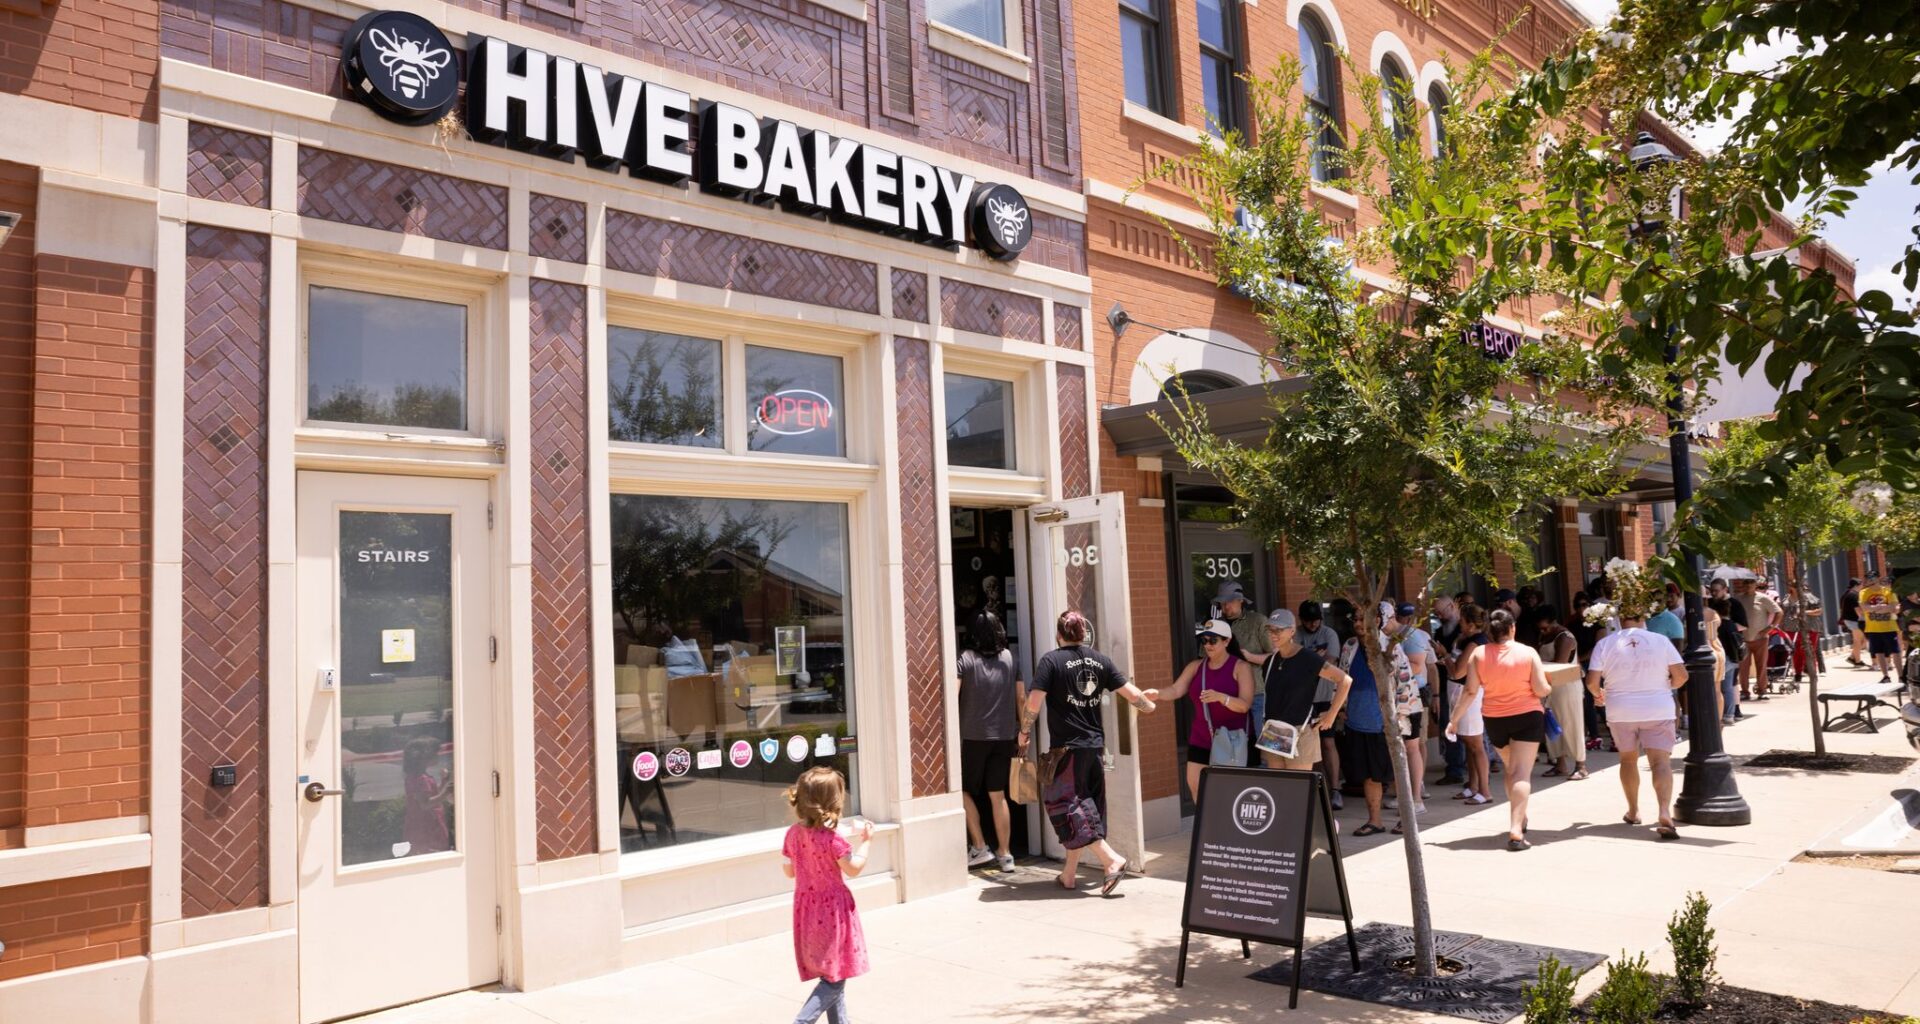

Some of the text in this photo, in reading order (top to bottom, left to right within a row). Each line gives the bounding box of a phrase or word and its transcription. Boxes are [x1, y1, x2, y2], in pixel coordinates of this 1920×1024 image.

[485, 35, 976, 242] HIVE BAKERY
[761, 395, 828, 428] OPEN
[358, 550, 430, 562] STAIRS
[1206, 558, 1241, 577] 350
[733, 748, 750, 761] food
[636, 760, 655, 774] food
[1240, 804, 1267, 819] HIVE
